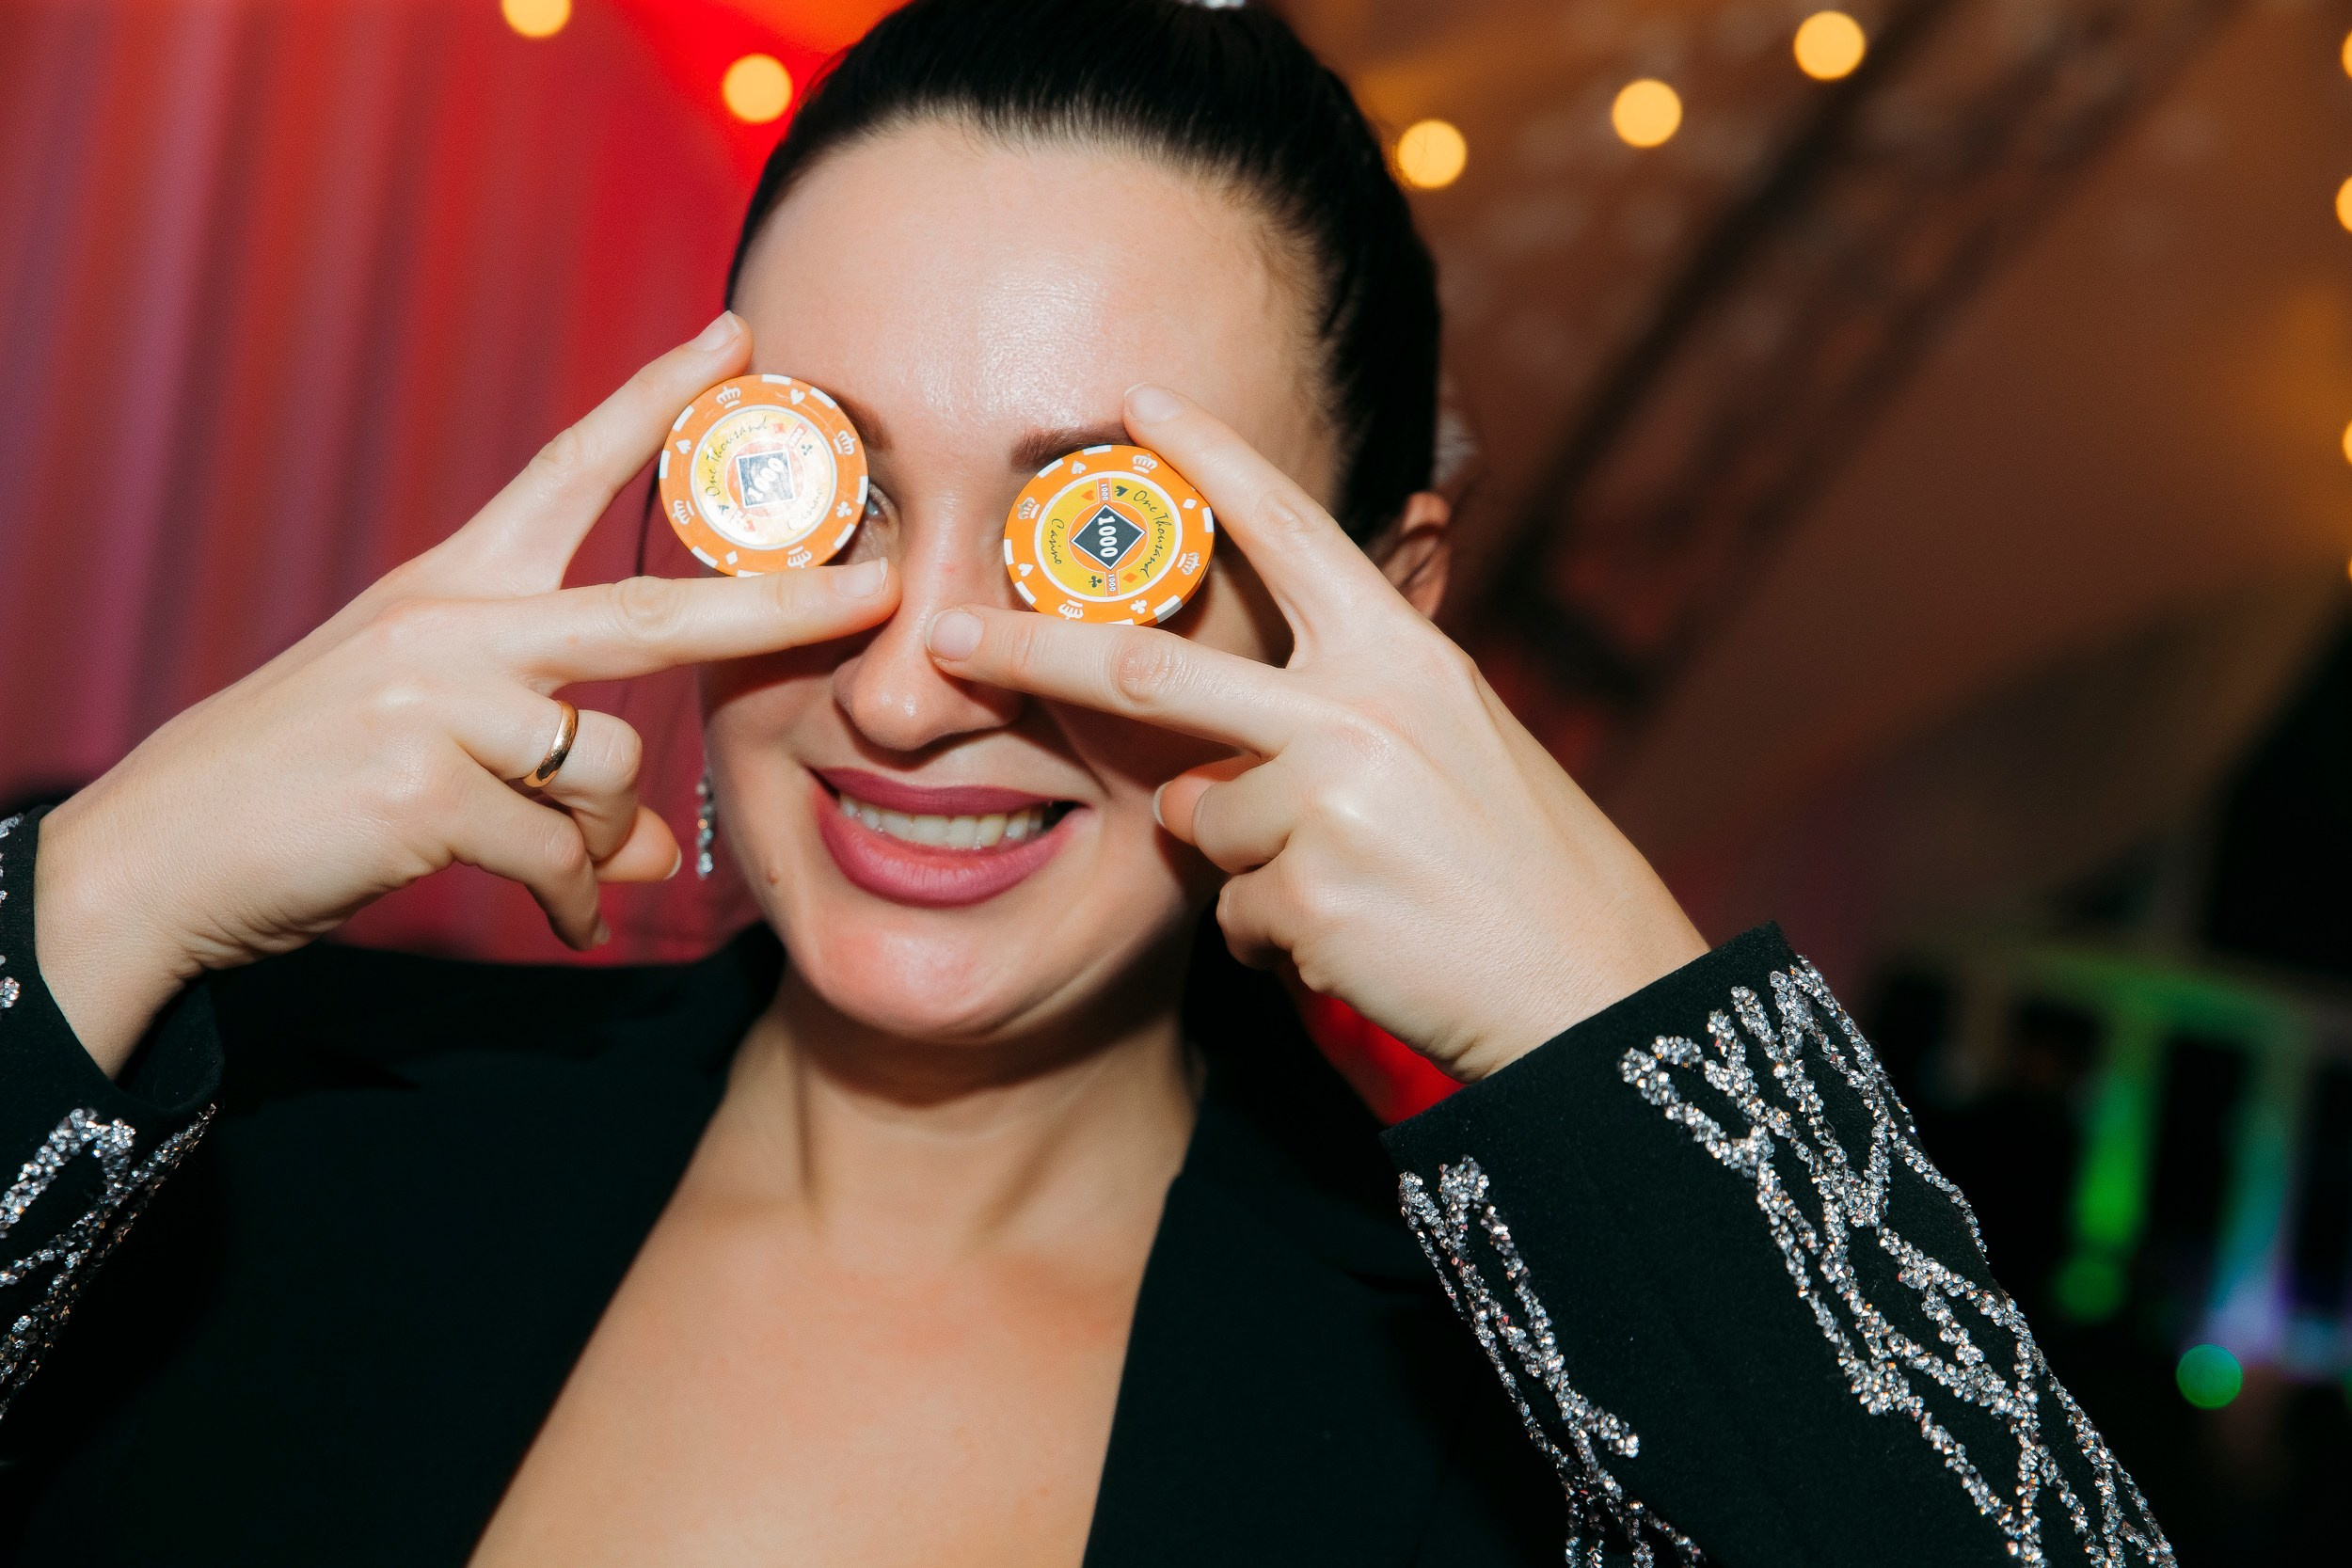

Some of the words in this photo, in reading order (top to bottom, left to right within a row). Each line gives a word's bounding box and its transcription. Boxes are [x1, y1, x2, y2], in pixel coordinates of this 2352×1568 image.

[707, 416, 768, 464] Thousand
[706, 465, 721, 497] One
[748, 458, 784, 500] 1000
[1101, 483, 1109, 501] 1000
[1134, 490, 1156, 513] One
[1048, 518, 1065, 565] Casino
[1097, 516, 1119, 558] 1000
[1140, 513, 1172, 578] Thousand
[1107, 574, 1117, 592] 1000
